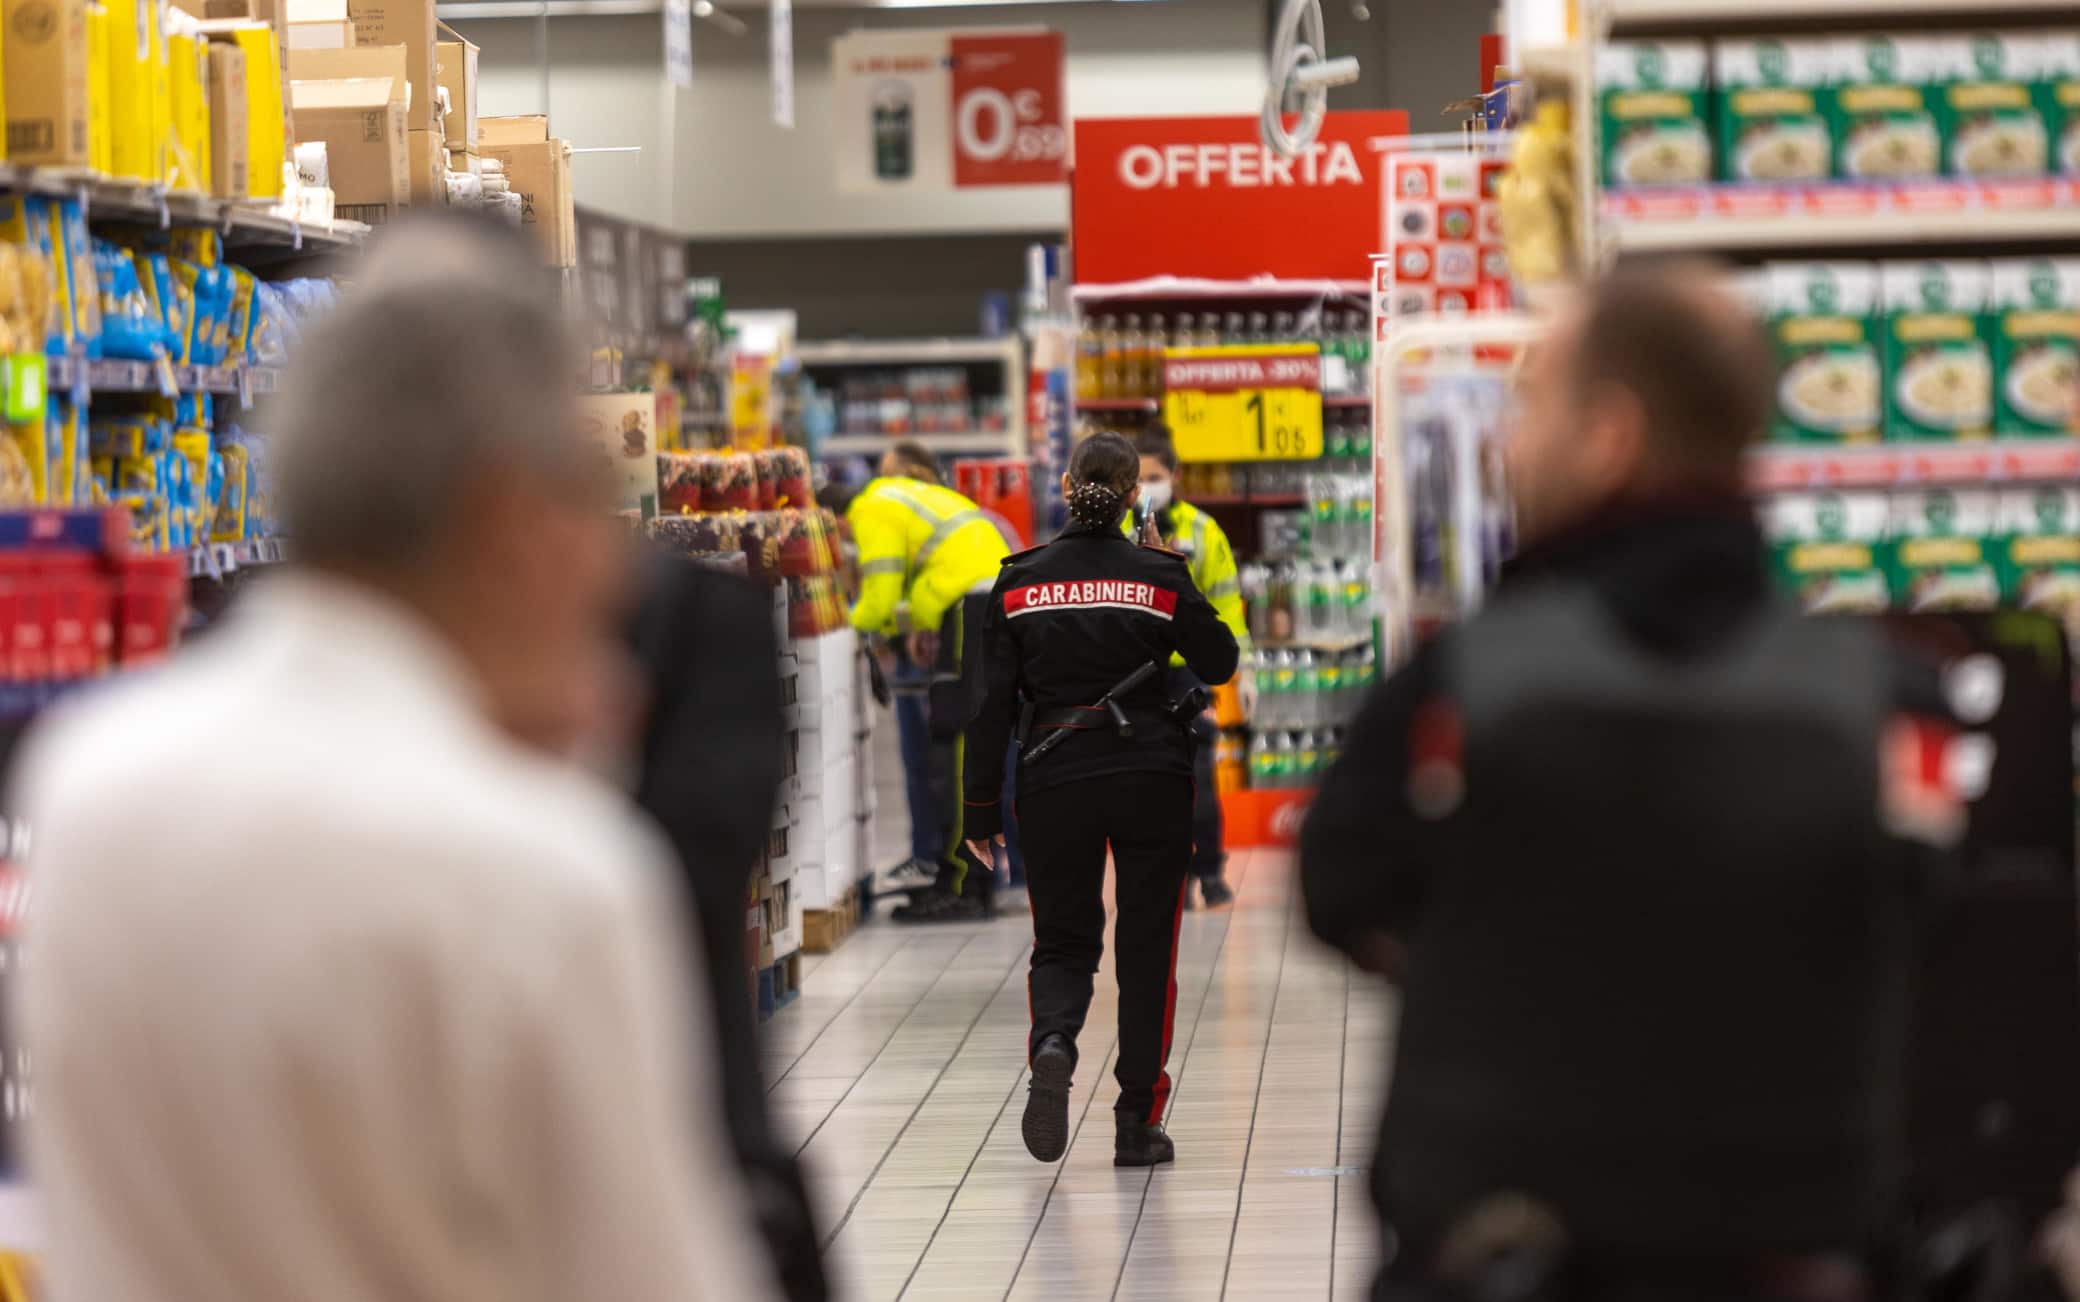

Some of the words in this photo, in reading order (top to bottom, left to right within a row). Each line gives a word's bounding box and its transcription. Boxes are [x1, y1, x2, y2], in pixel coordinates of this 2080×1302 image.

[958, 86, 1014, 161] 0
[1119, 141, 1363, 188] OFFERTA
[1168, 361, 1265, 383] OFFERTA
[1246, 393, 1265, 452] 1
[1025, 581, 1155, 606] CARABINIERI
